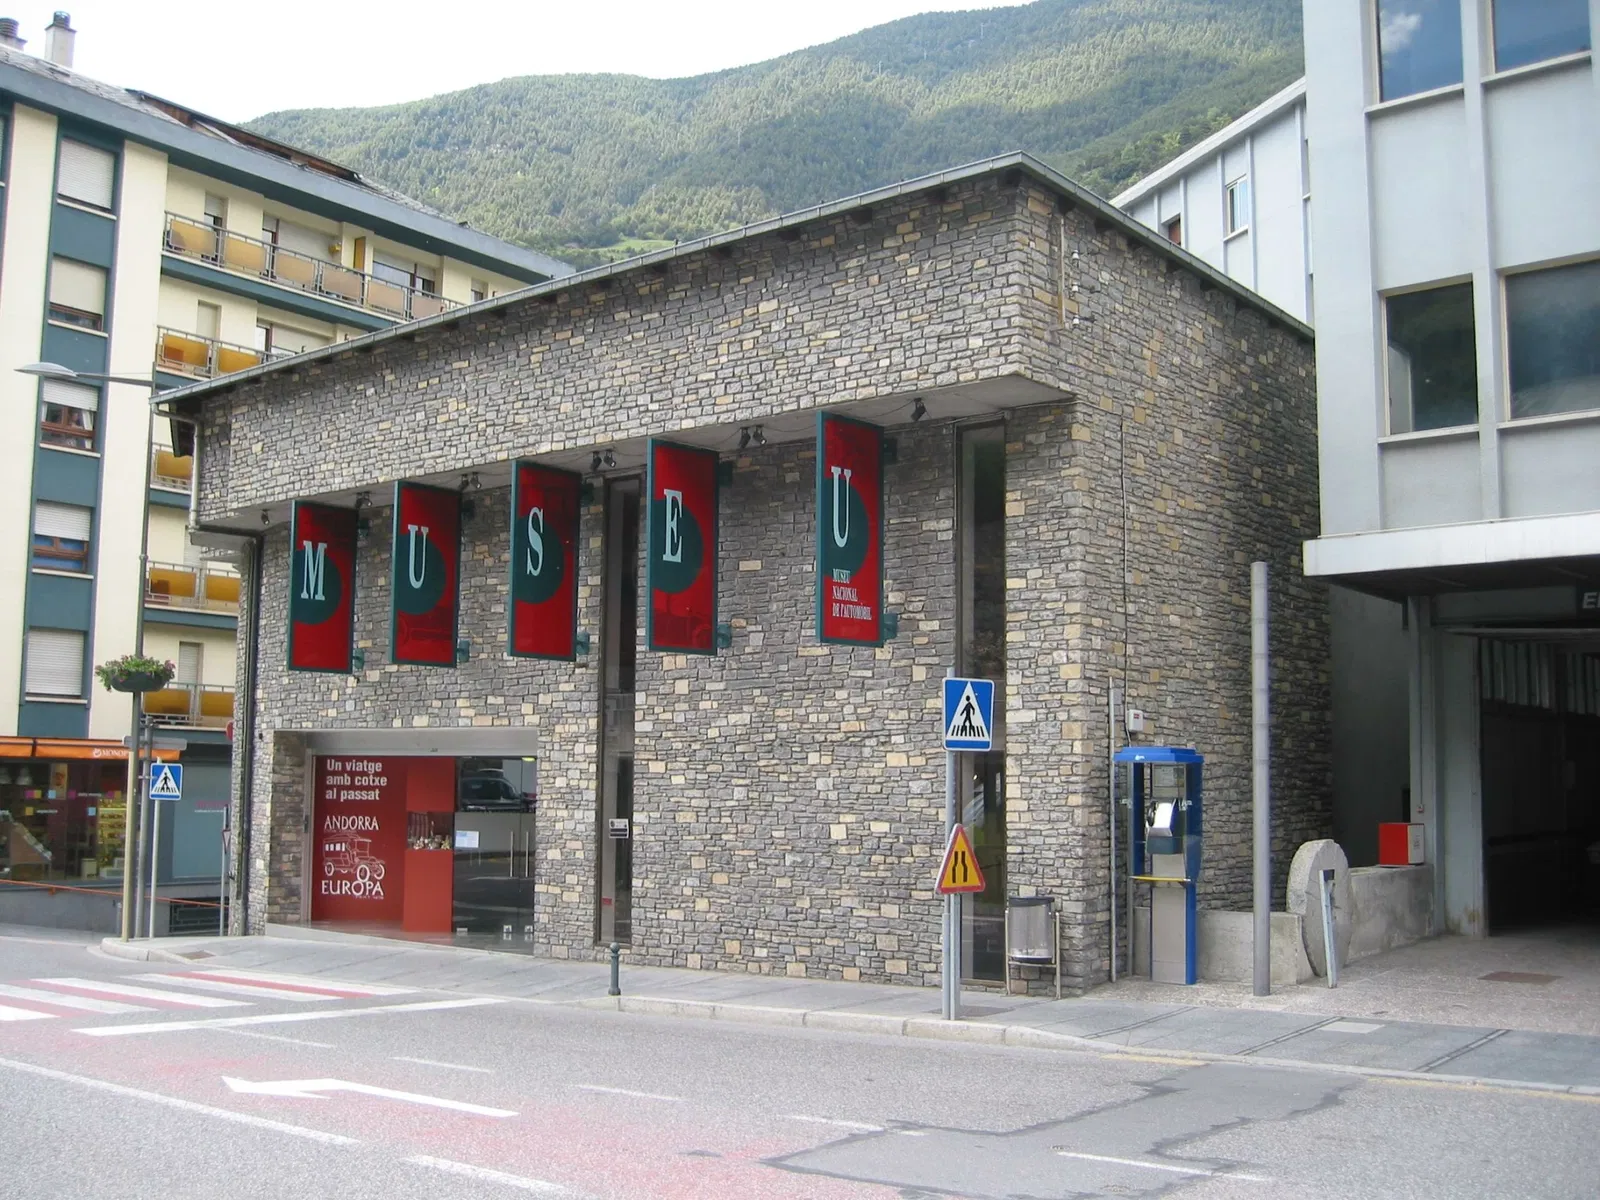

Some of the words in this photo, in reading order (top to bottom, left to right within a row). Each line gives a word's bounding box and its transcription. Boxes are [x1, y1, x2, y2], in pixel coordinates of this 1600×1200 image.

[300, 540, 328, 601] M
[407, 524, 430, 589] U
[526, 506, 545, 577] S
[662, 488, 683, 563] E
[831, 466, 852, 548] U
[832, 568, 851, 584] MUSEU
[832, 585, 858, 602] NACIONAL
[832, 602, 840, 617] DE
[326, 758, 342, 771] Un
[345, 759, 382, 774] viatge
[326, 773, 351, 786] amb
[355, 774, 388, 787] cotxe
[325, 787, 337, 800] al
[340, 788, 380, 802] passat
[324, 815, 379, 830] ANDORRA
[321, 880, 384, 896] EUROPA
